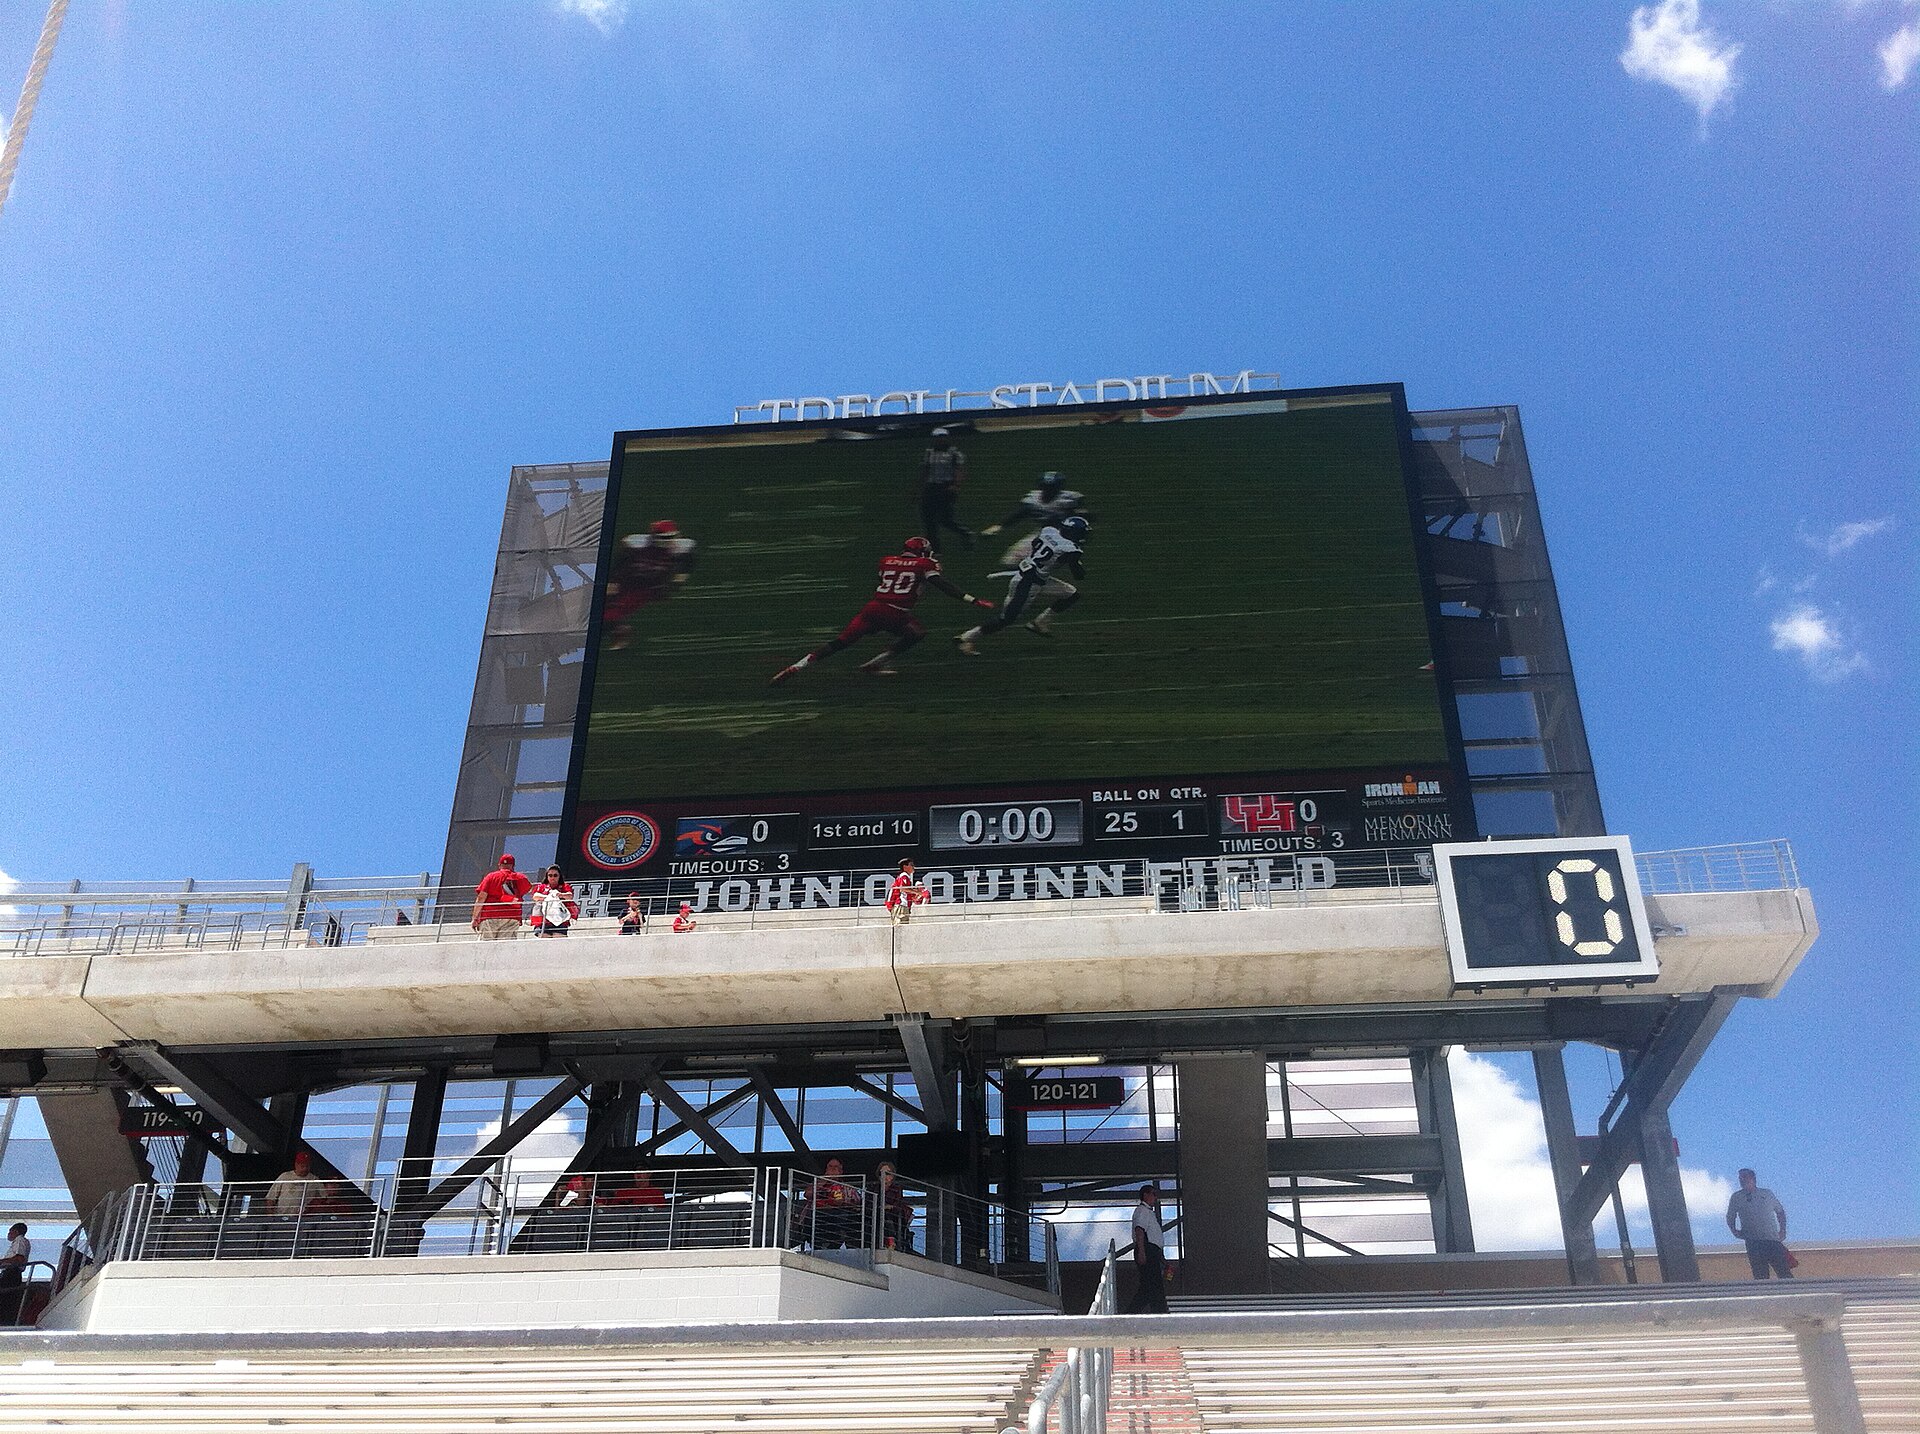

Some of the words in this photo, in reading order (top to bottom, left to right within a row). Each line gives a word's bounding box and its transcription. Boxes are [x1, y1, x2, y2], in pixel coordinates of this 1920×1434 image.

[876, 570, 916, 594] 50
[1092, 789, 1132, 802] BALL
[1138, 788, 1160, 800] ON
[1170, 787, 1207, 800] QTR.
[1172, 810, 1184, 830] 1
[1300, 799, 1317, 822] 0
[752, 820, 769, 842] 0
[813, 823, 841, 838] 1st
[849, 821, 884, 837] and
[891, 819, 914, 835] 10
[958, 806, 1053, 844] 0:00
[1104, 812, 1138, 833] 25
[1365, 813, 1452, 830] MEMORIAL
[1219, 837, 1322, 853] TIMEOUTS:
[1331, 831, 1345, 848] 3
[1365, 825, 1453, 841] HERMANN
[669, 859, 766, 875] TIMEOUTS:
[777, 853, 790, 871] 3
[685, 876, 844, 912] JOHN
[863, 864, 1126, 906] OQUINN
[1148, 857, 1337, 894] FIELD
[1547, 859, 1624, 956] 0
[1031, 1083, 1098, 1100] 120-121
[143, 1110, 204, 1127] 119-0
